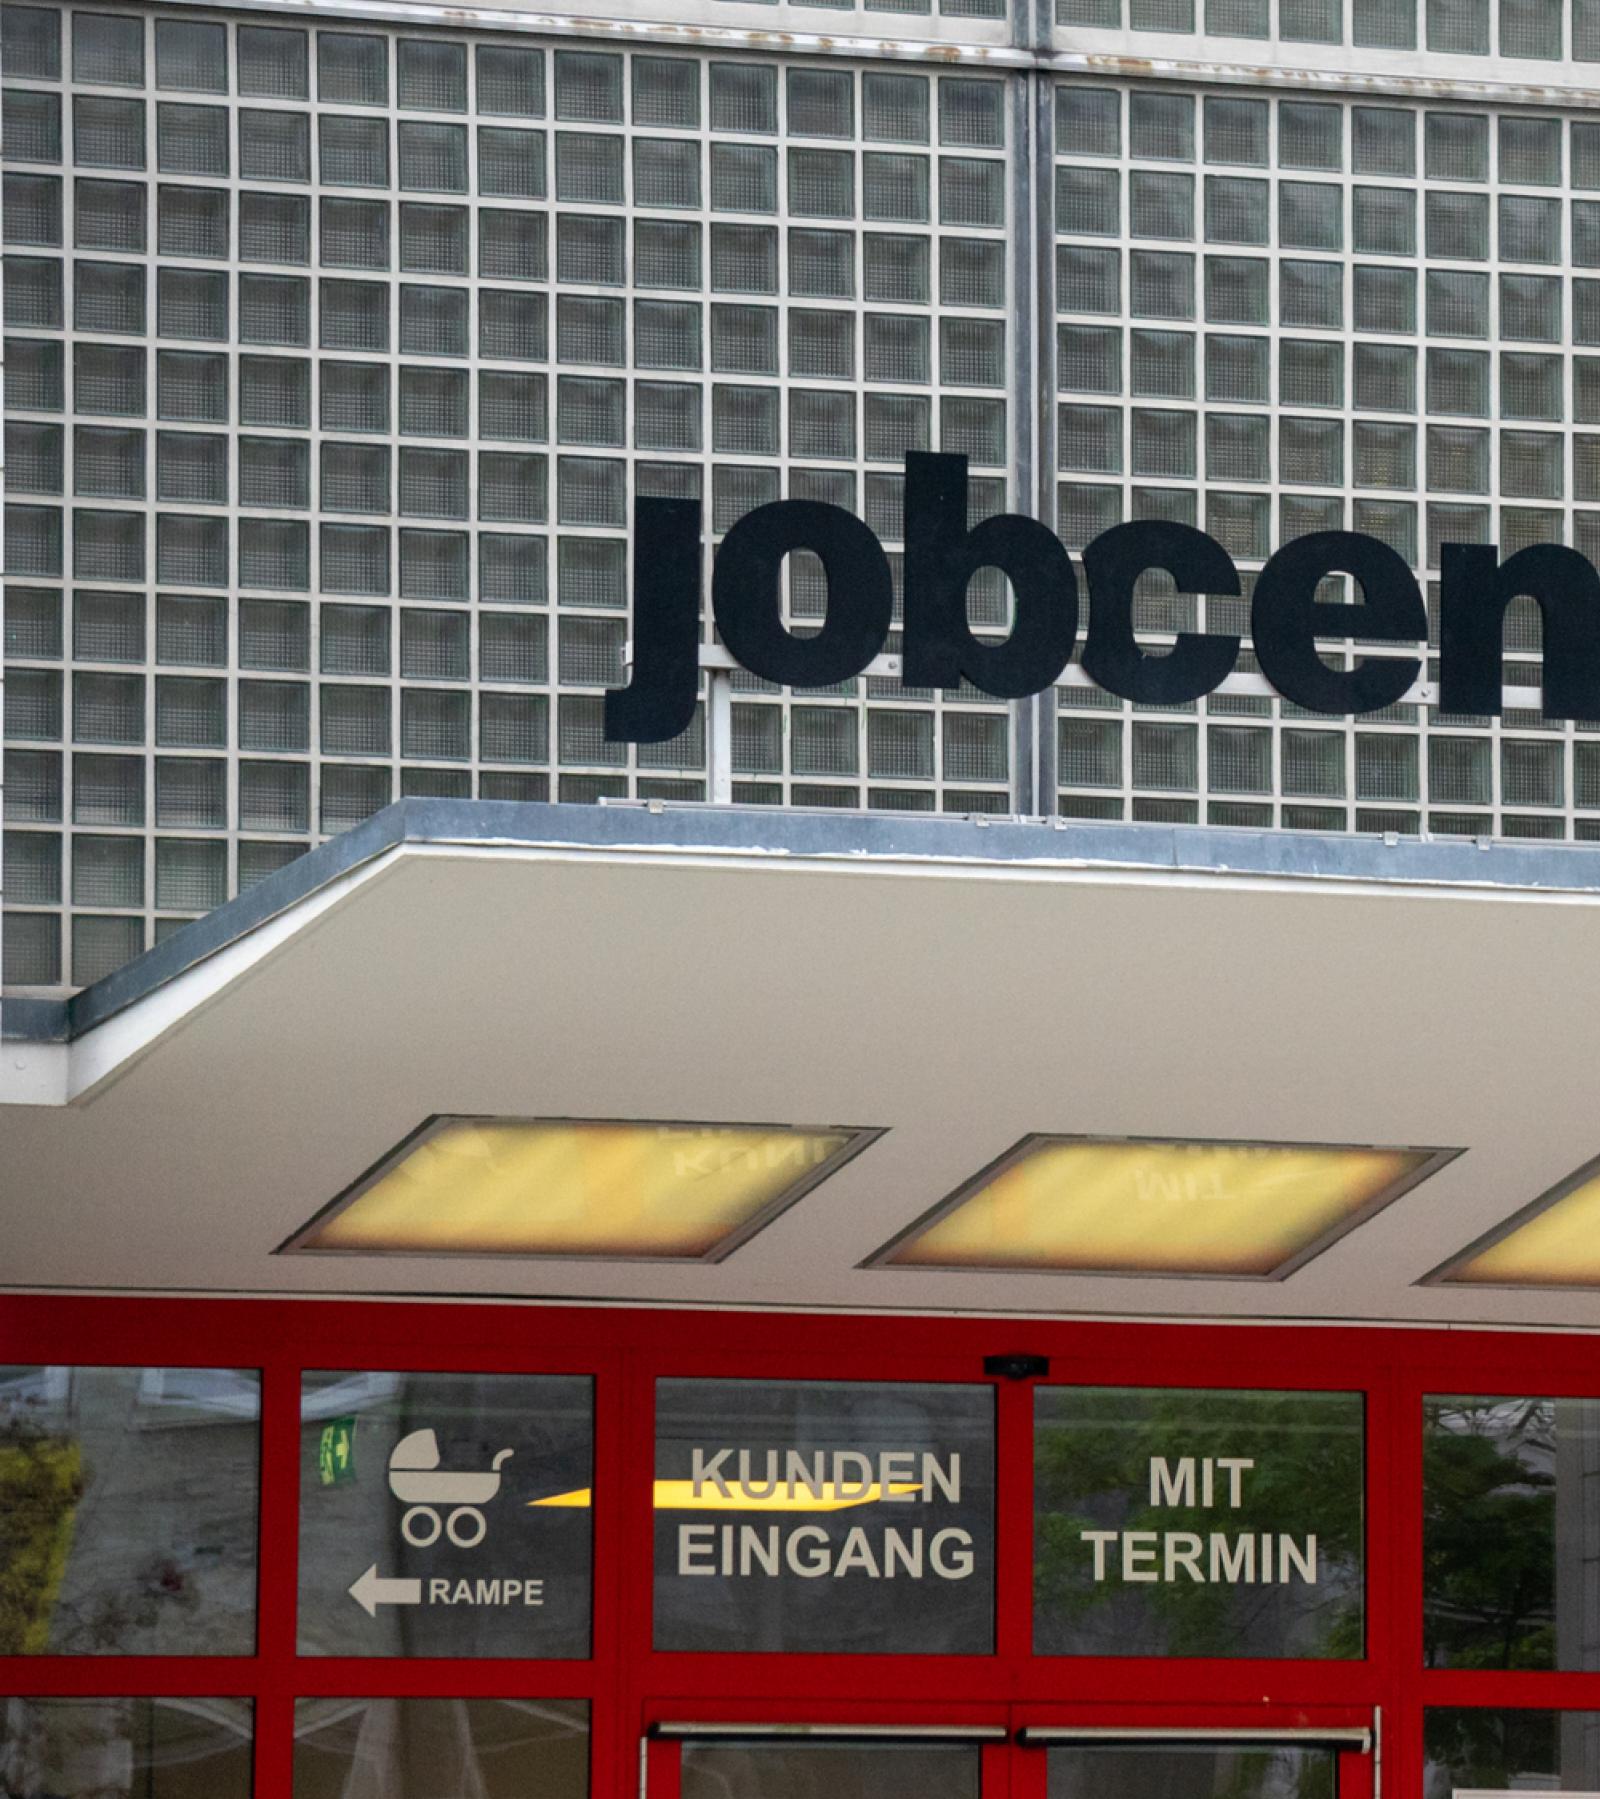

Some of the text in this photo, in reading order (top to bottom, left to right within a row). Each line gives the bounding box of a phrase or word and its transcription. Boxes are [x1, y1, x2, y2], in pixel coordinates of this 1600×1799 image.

[692, 1448, 961, 1504] KUNDEN
[1149, 1456, 1254, 1508] MIT
[677, 1524, 974, 1580] EINGANG
[1080, 1530, 1318, 1585] TERMIN
[428, 1578, 545, 1606] RAMPE
